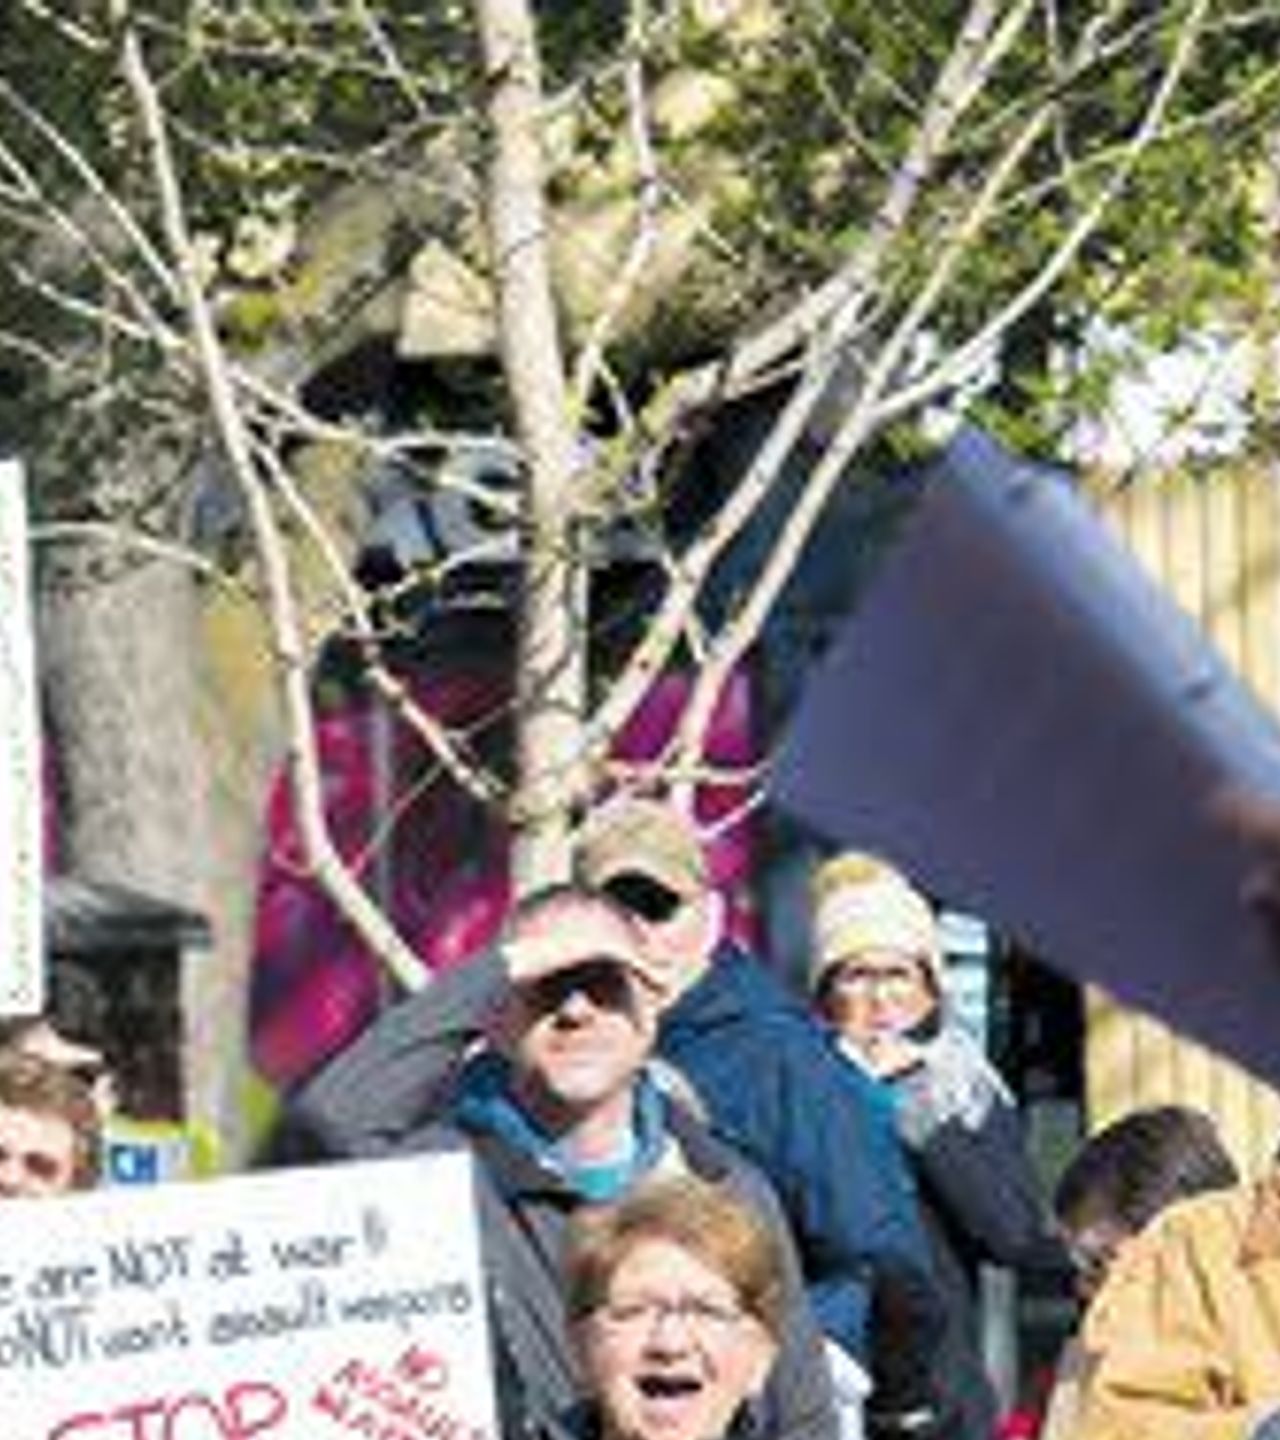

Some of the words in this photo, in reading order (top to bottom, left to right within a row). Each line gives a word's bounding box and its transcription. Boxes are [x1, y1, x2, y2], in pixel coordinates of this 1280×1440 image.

[29, 1264, 94, 1295] are
[110, 1237, 190, 1287] NOT
[209, 1235, 249, 1277] at
[96, 1306, 189, 1359] want
